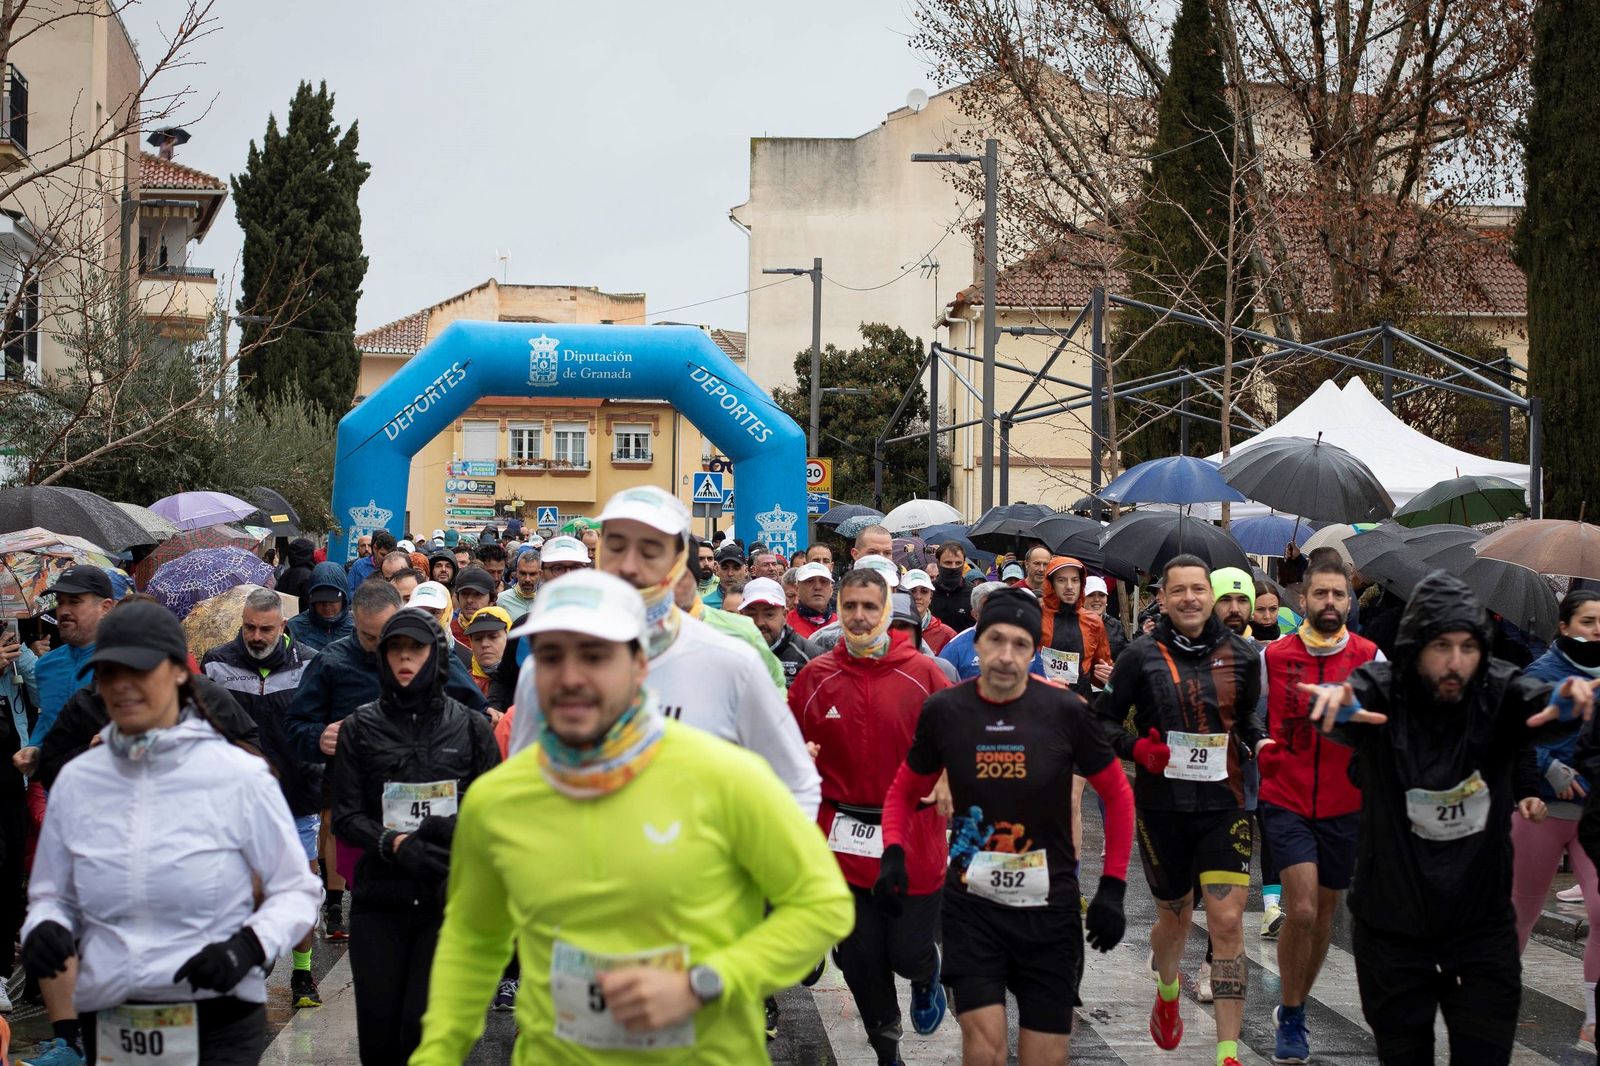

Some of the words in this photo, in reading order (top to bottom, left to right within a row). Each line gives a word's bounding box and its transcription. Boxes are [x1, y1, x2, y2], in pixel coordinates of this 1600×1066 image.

[563, 349, 633, 364] Diputación
[563, 367, 577, 379] de
[580, 367, 632, 379] Granada
[383, 361, 467, 441] DEPORTES
[690, 366, 773, 443] DEPORTES
[807, 469, 821, 478] 30
[1050, 658, 1069, 672] 338
[975, 744, 996, 752] GRAN
[996, 744, 1026, 752] PREMIO
[1189, 747, 1208, 764] 29
[975, 752, 1026, 763] FONDO
[975, 762, 1027, 778] 2025
[410, 801, 431, 819] 45
[1436, 801, 1466, 821] 271
[850, 823, 876, 840] 160
[990, 870, 1026, 888] 352
[120, 1027, 164, 1056] 590
